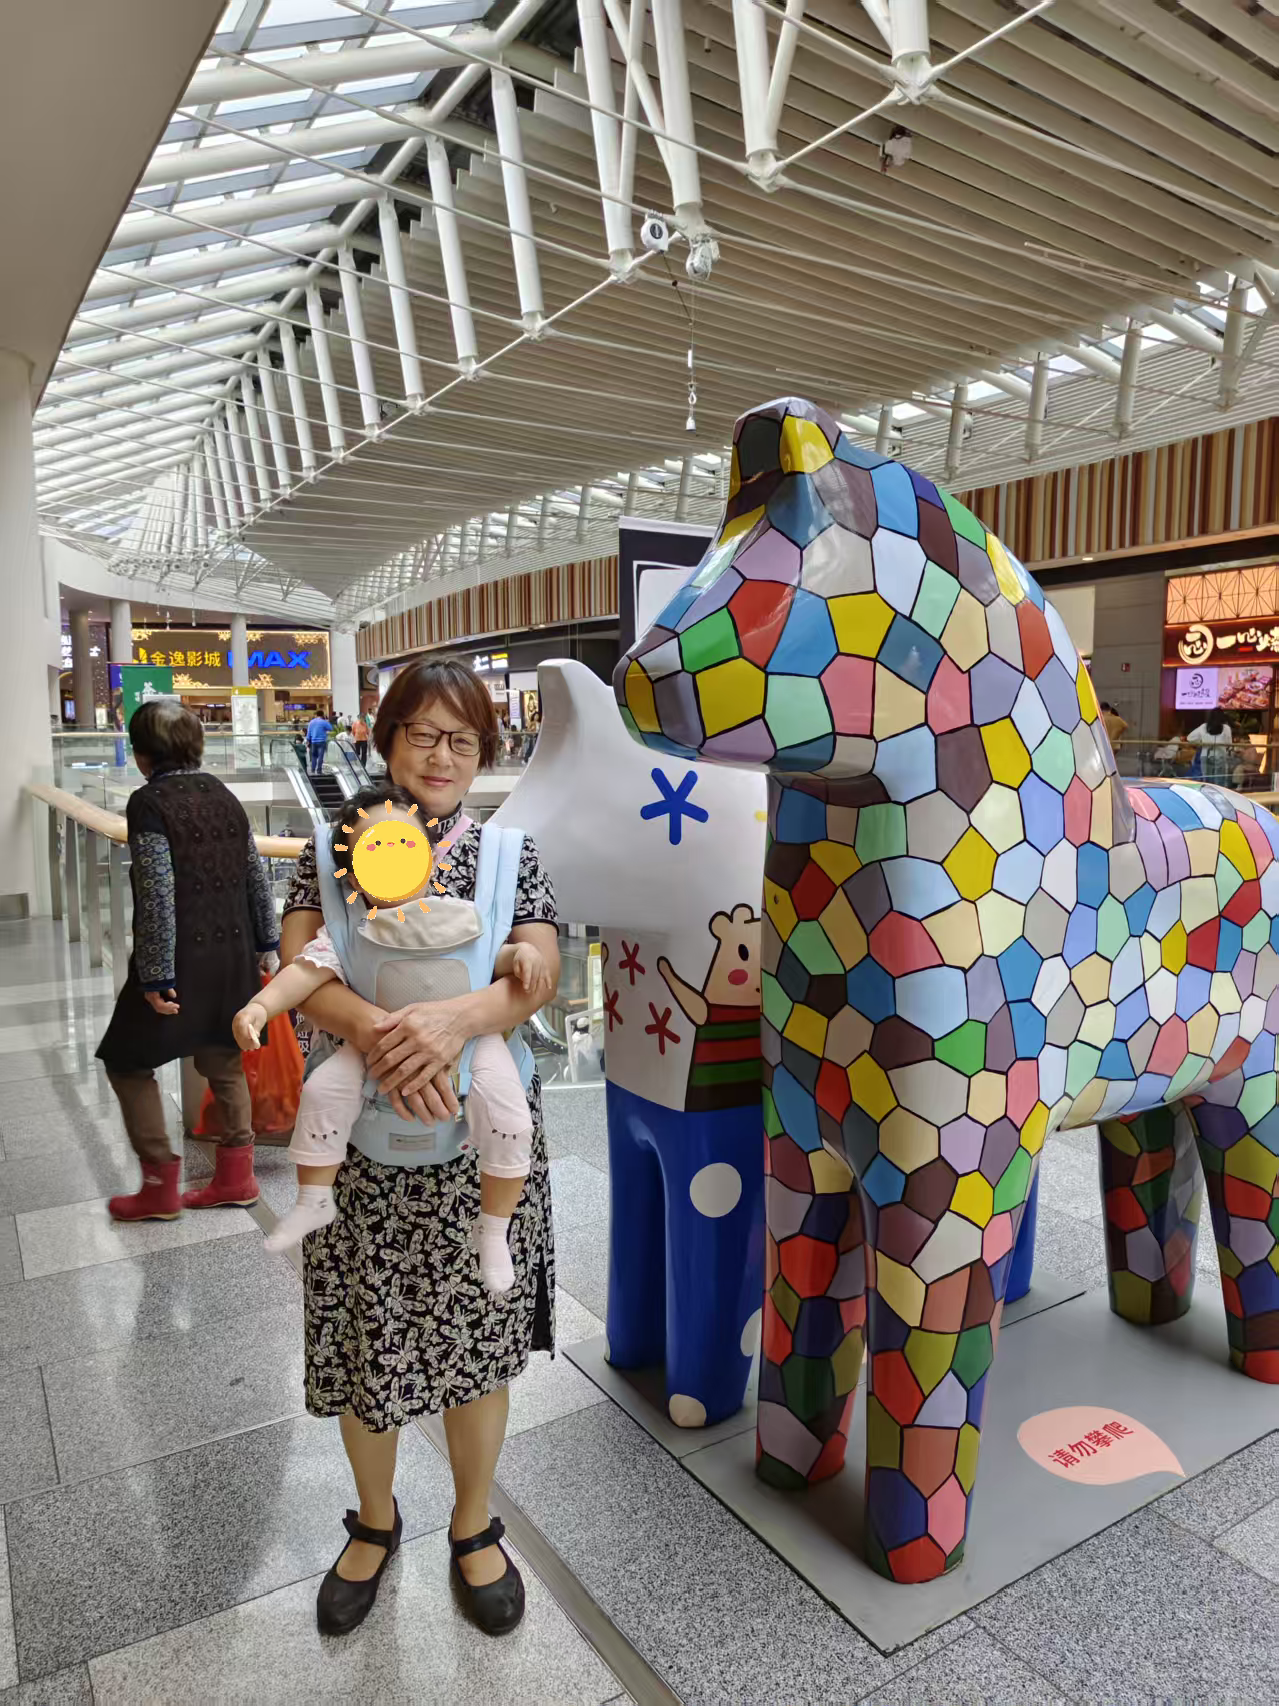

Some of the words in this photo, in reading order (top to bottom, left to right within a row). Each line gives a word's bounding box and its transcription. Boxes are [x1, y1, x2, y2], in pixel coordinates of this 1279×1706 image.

[150, 651, 221, 667] 金逸影城
[1048, 1421, 1134, 1468] 请勿攀爬
